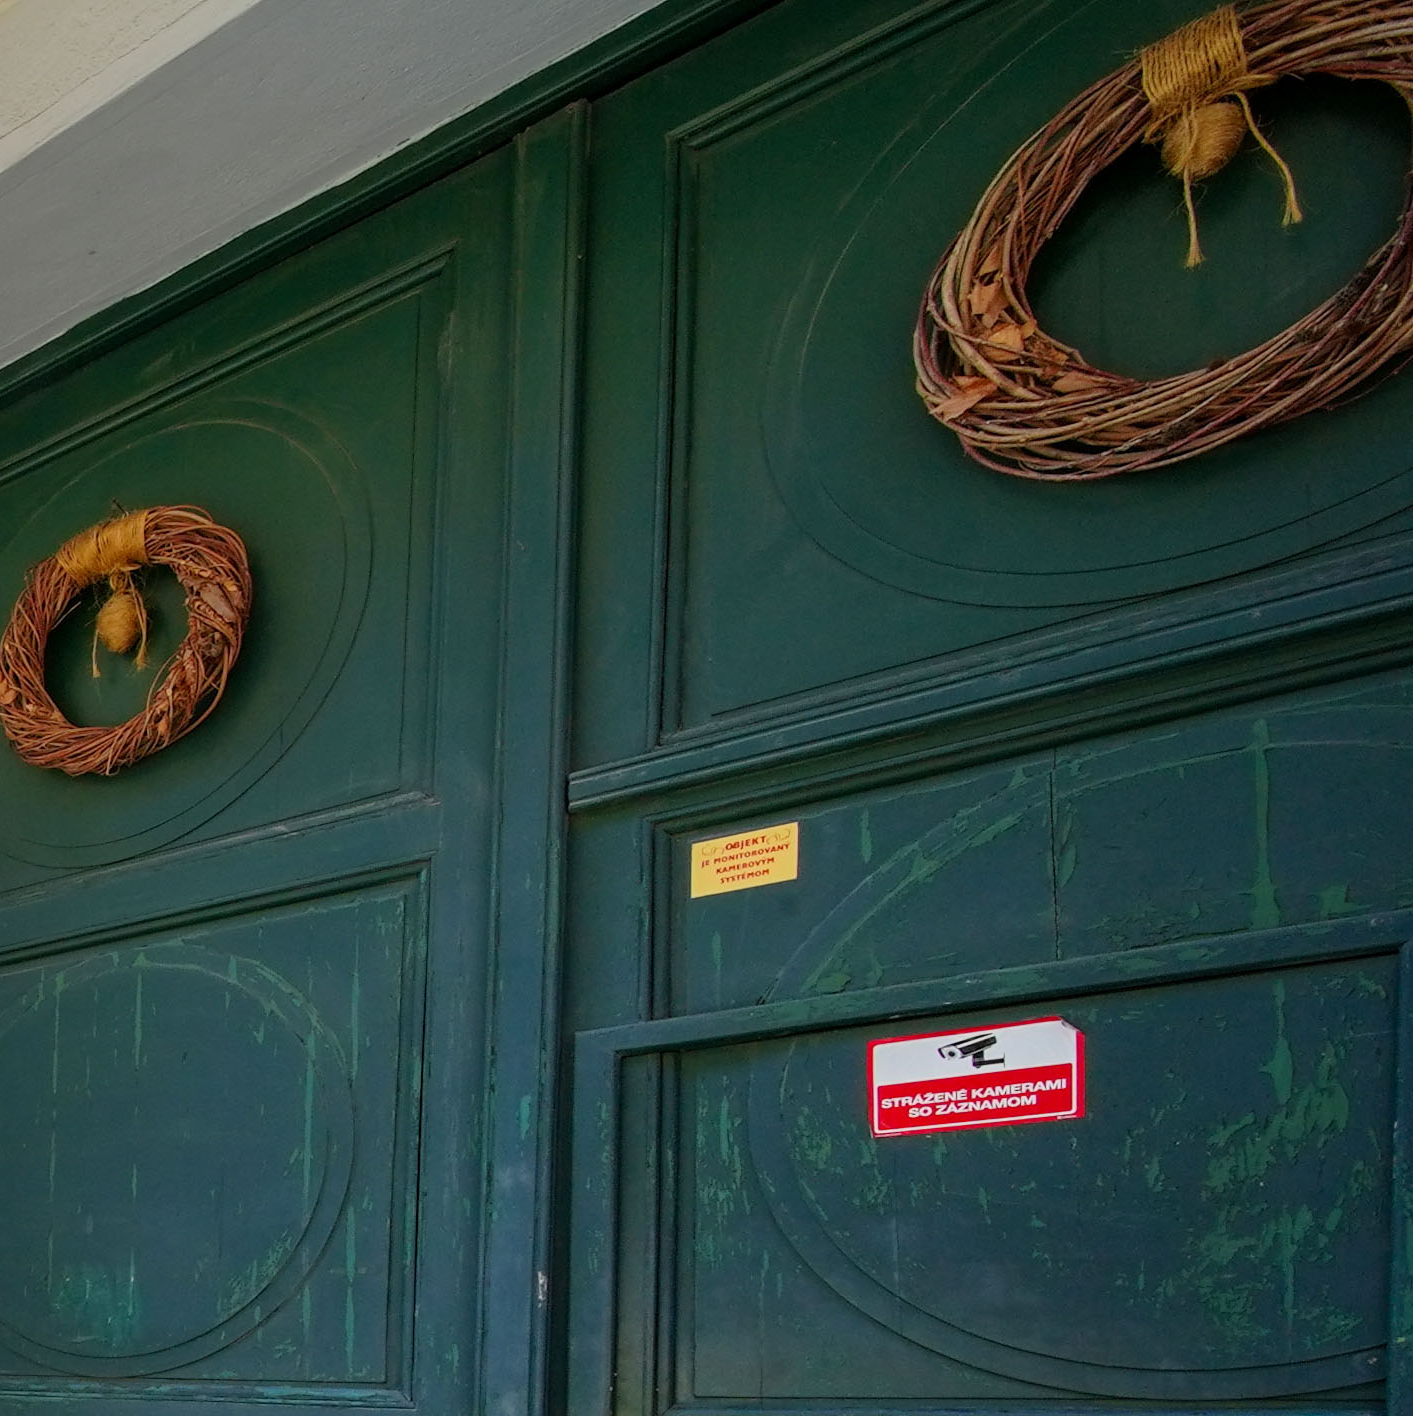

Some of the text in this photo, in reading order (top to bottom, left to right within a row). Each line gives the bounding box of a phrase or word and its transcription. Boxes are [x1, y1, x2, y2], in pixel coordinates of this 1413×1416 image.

[725, 835, 766, 851] OBJEKT
[701, 860, 710, 869] JE
[881, 1078, 1067, 1109] STRÁŽENÉ KAMERAMI
[908, 1094, 1037, 1118] SO ZÁZNAMOM
